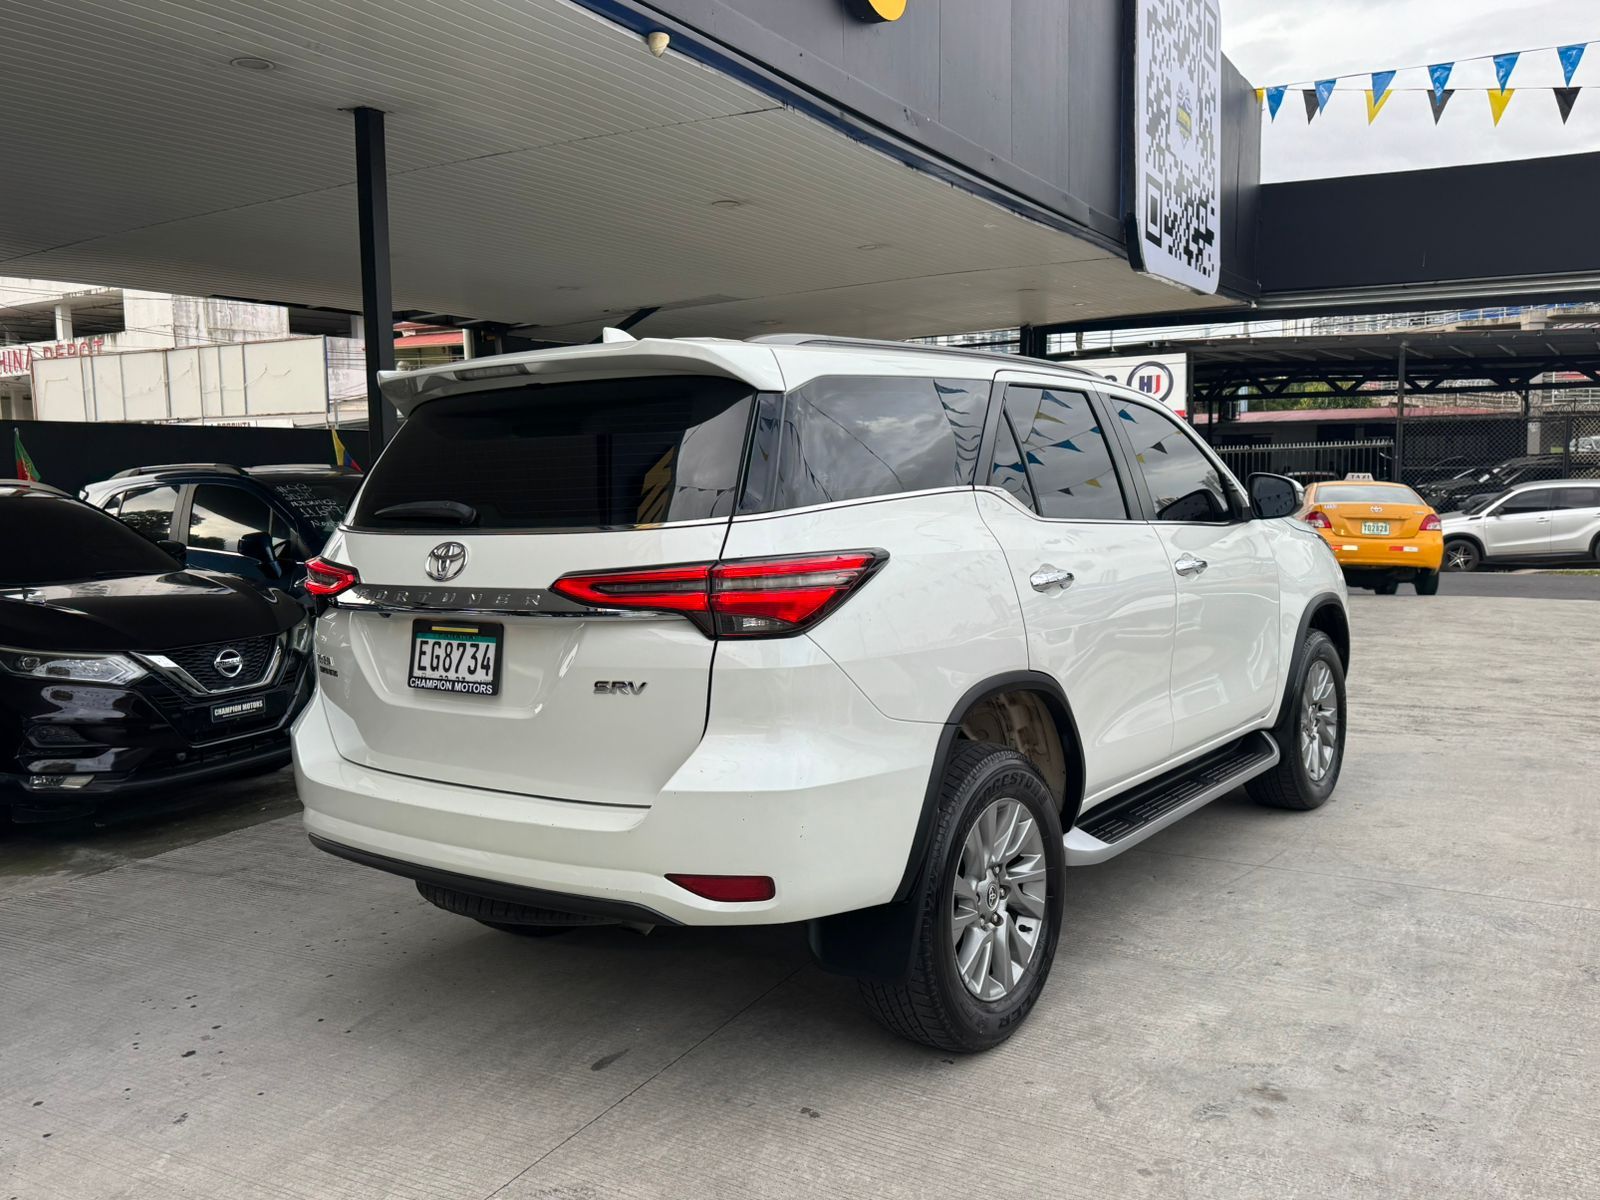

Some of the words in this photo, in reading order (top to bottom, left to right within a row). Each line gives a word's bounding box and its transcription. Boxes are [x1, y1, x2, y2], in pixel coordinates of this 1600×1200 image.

[356, 589, 541, 606] FORTUNER
[417, 640, 491, 676] EG8734
[410, 678, 452, 691] CHAMPION
[454, 682, 493, 694] MOTORS
[593, 681, 647, 695] SRV
[214, 704, 241, 716] CHAMPION
[242, 700, 263, 711] MOTORS
